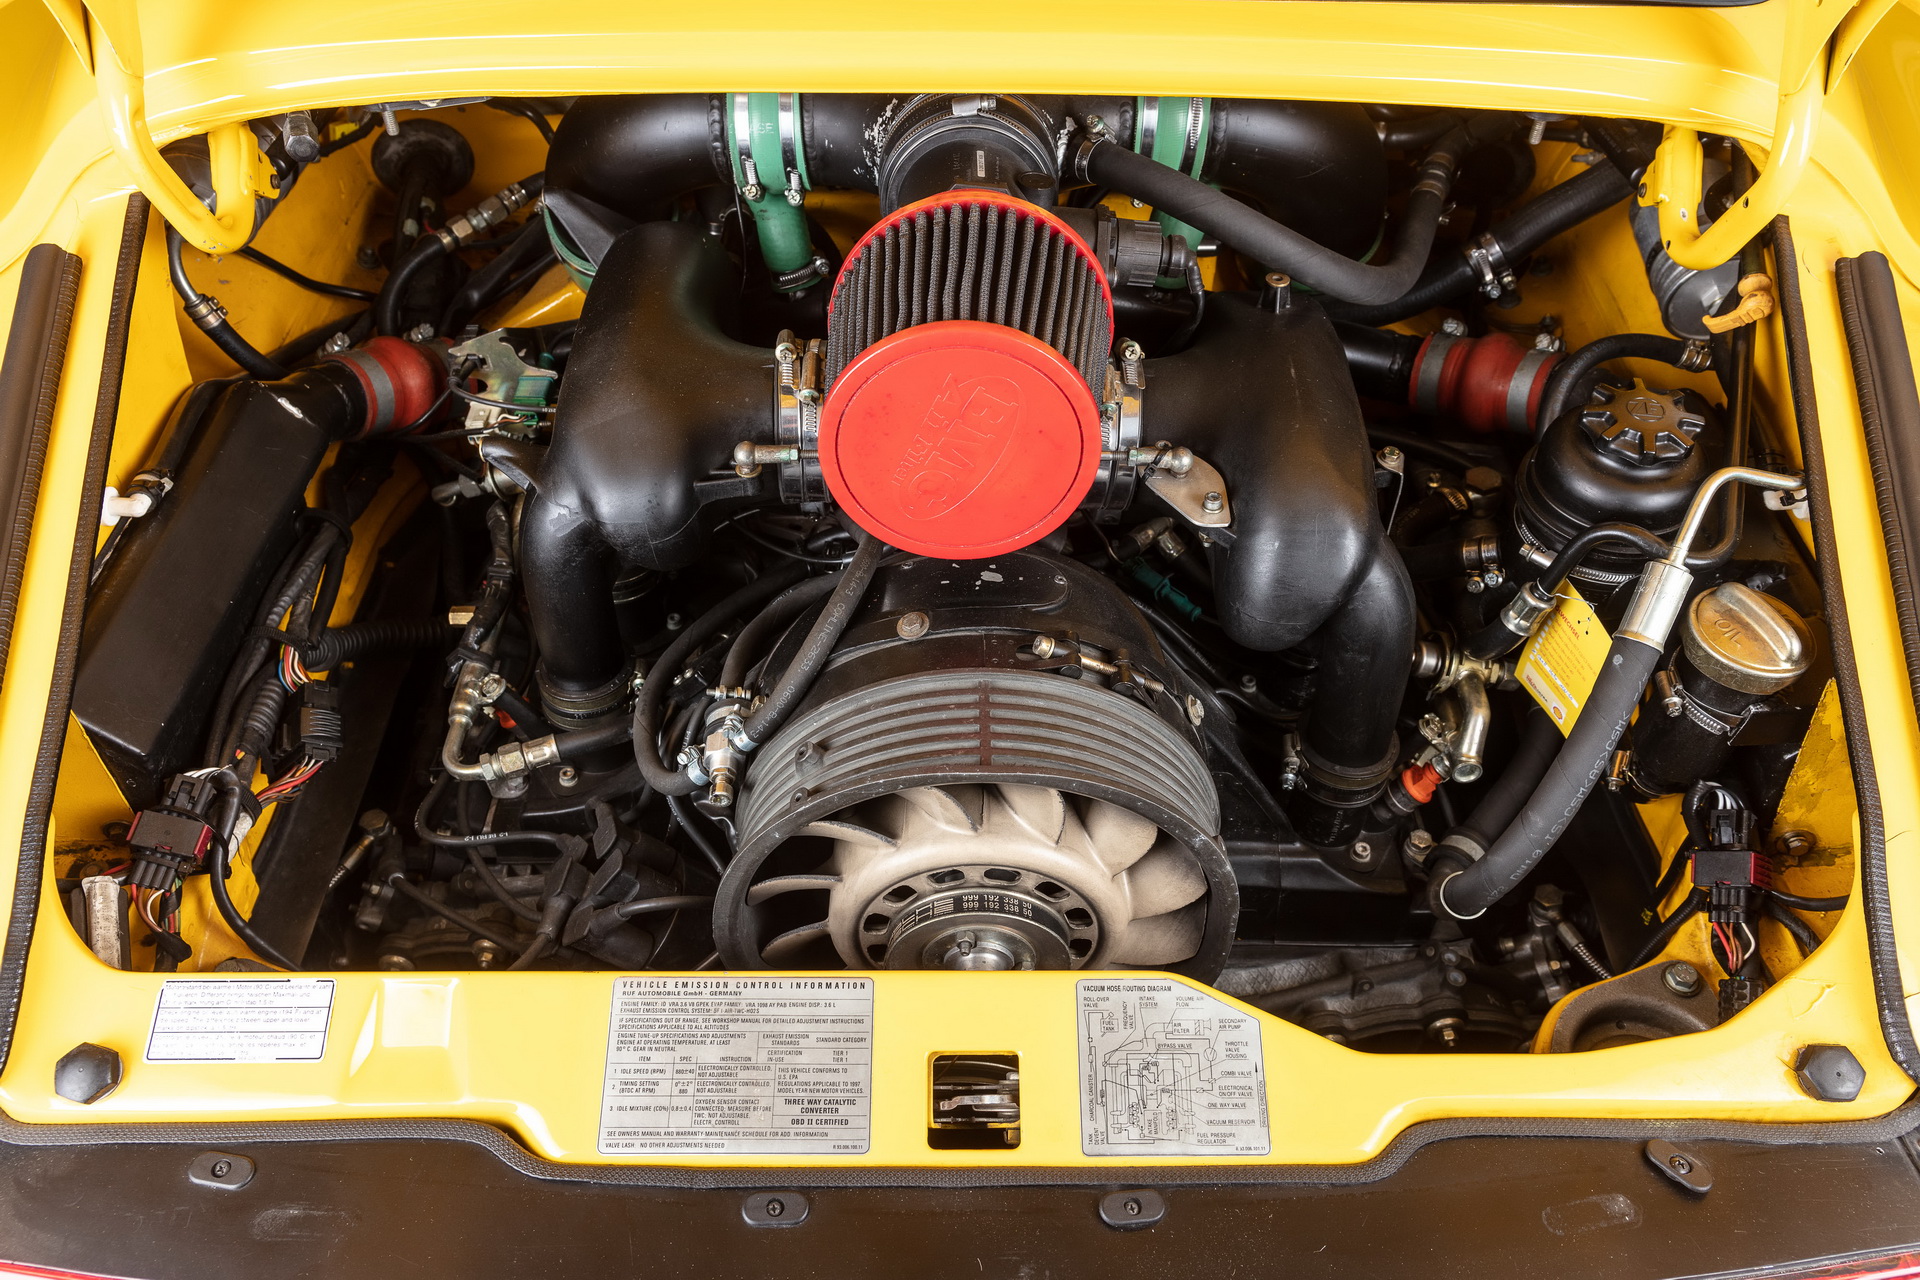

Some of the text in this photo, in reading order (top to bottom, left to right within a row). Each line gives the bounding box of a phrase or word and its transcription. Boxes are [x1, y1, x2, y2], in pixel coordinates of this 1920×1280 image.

[1714, 617, 1742, 648] OIL
[962, 901, 979, 909] 999
[983, 901, 1000, 909] 192
[1003, 903, 1019, 913] 338
[1022, 908, 1033, 917] 50
[622, 981, 668, 989] VEHICLE
[674, 981, 729, 989] EMISSION
[736, 981, 783, 989] CONTROL
